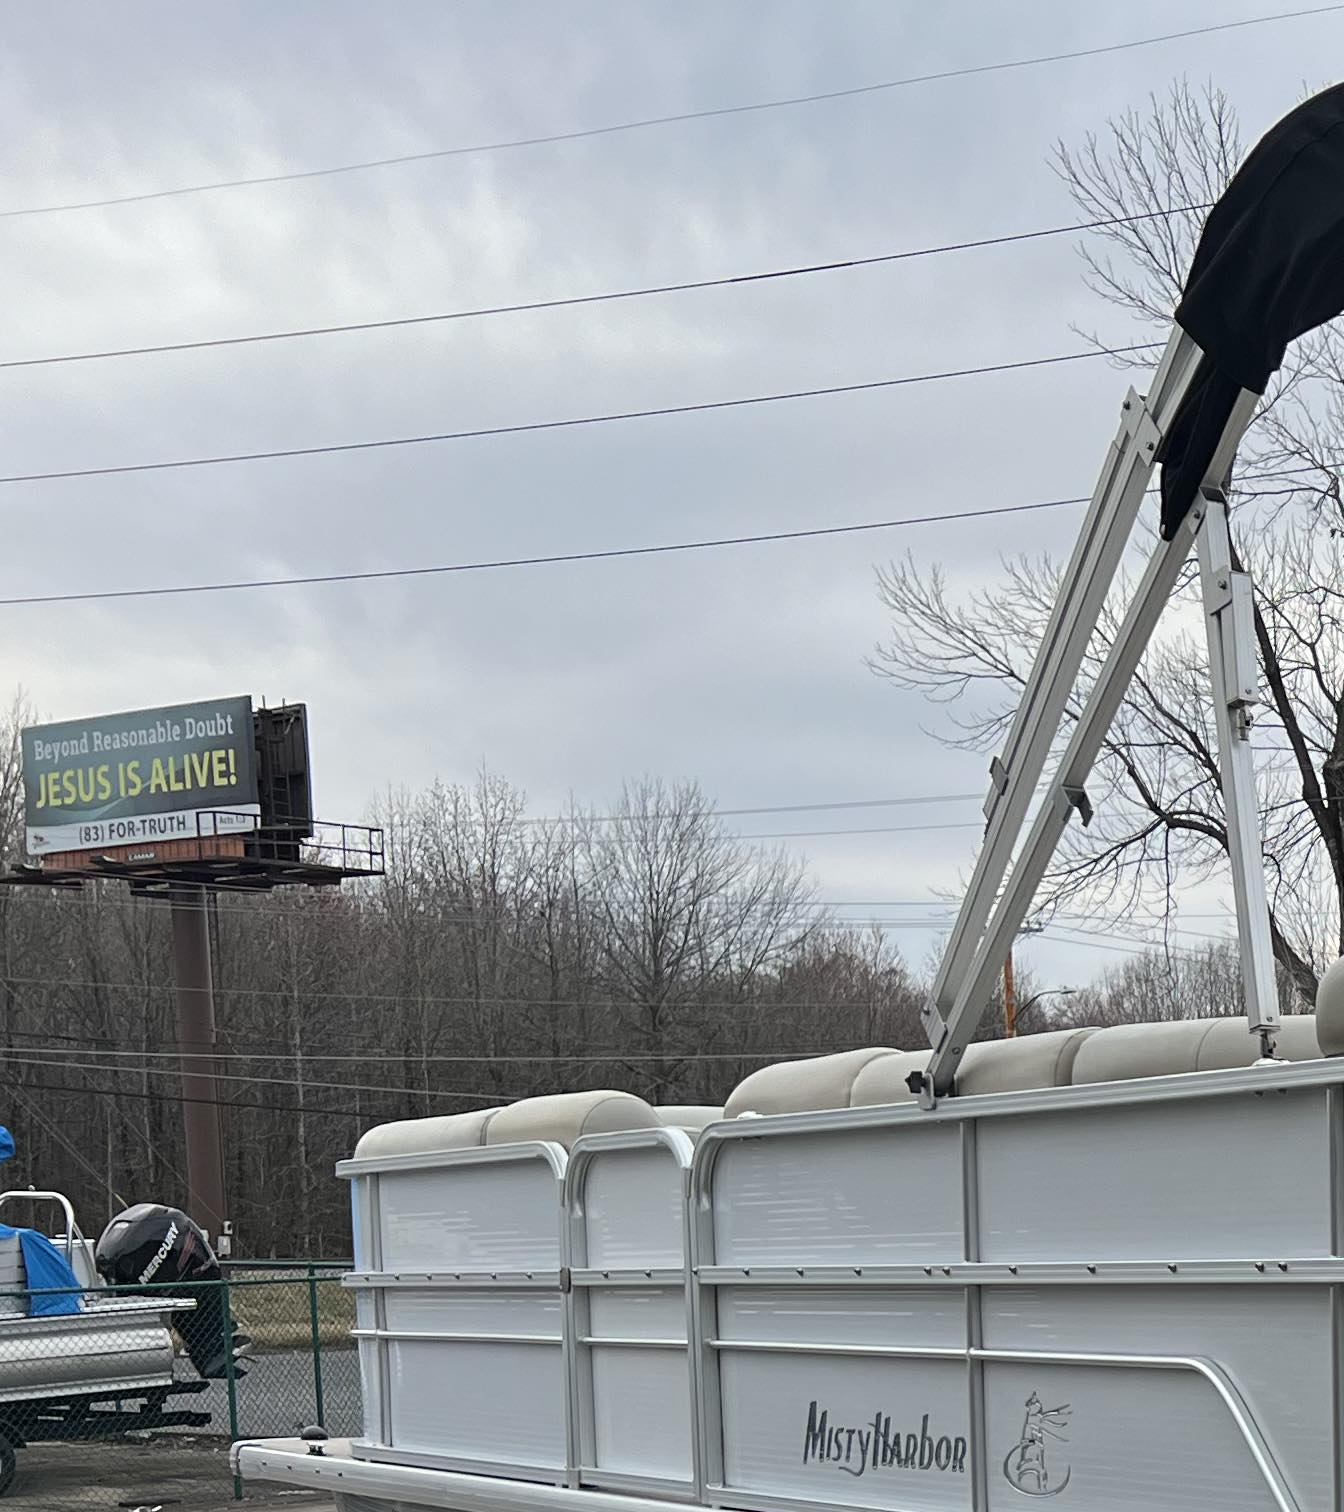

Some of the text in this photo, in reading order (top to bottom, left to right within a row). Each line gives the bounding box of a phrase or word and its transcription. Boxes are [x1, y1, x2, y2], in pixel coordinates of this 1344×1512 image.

[34, 713, 234, 764] Beyond Reasonable Doubt
[36, 749, 238, 809] JESUS IS ALIVE!
[79, 815, 187, 845] (83) FOR-TRUTH
[138, 1221, 179, 1285] MERCURY
